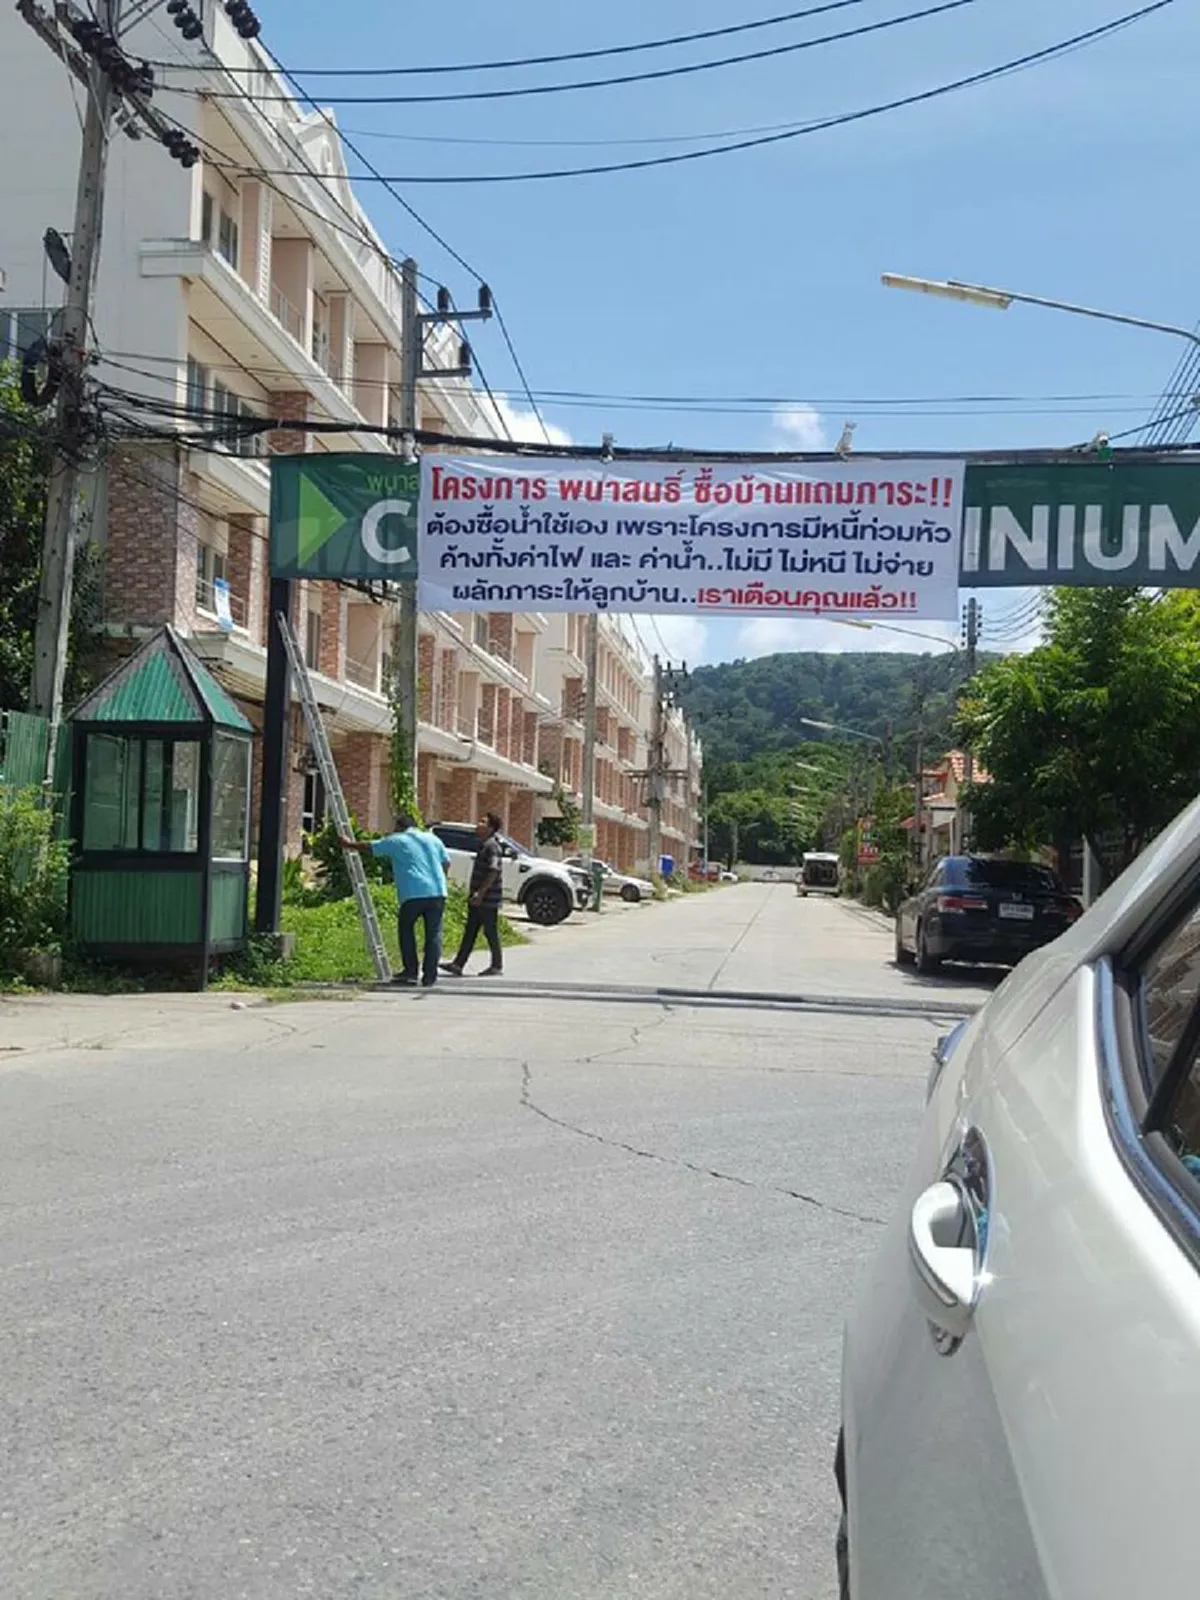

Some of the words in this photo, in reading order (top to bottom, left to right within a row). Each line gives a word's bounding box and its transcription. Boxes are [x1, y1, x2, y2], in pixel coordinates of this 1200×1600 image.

[431, 466, 547, 502] โครงการ
[426, 505, 608, 536] ต้องซื้อน้ำใช้เอง
[616, 508, 952, 543] เพราะโครงการมีหนี้ท่วมหัว
[440, 538, 584, 568] ค้างทั้งค่าไฟ
[591, 552, 631, 568] และ
[779, 549, 846, 573] ไม่หนี
[853, 551, 934, 576] ไม่จ่าย
